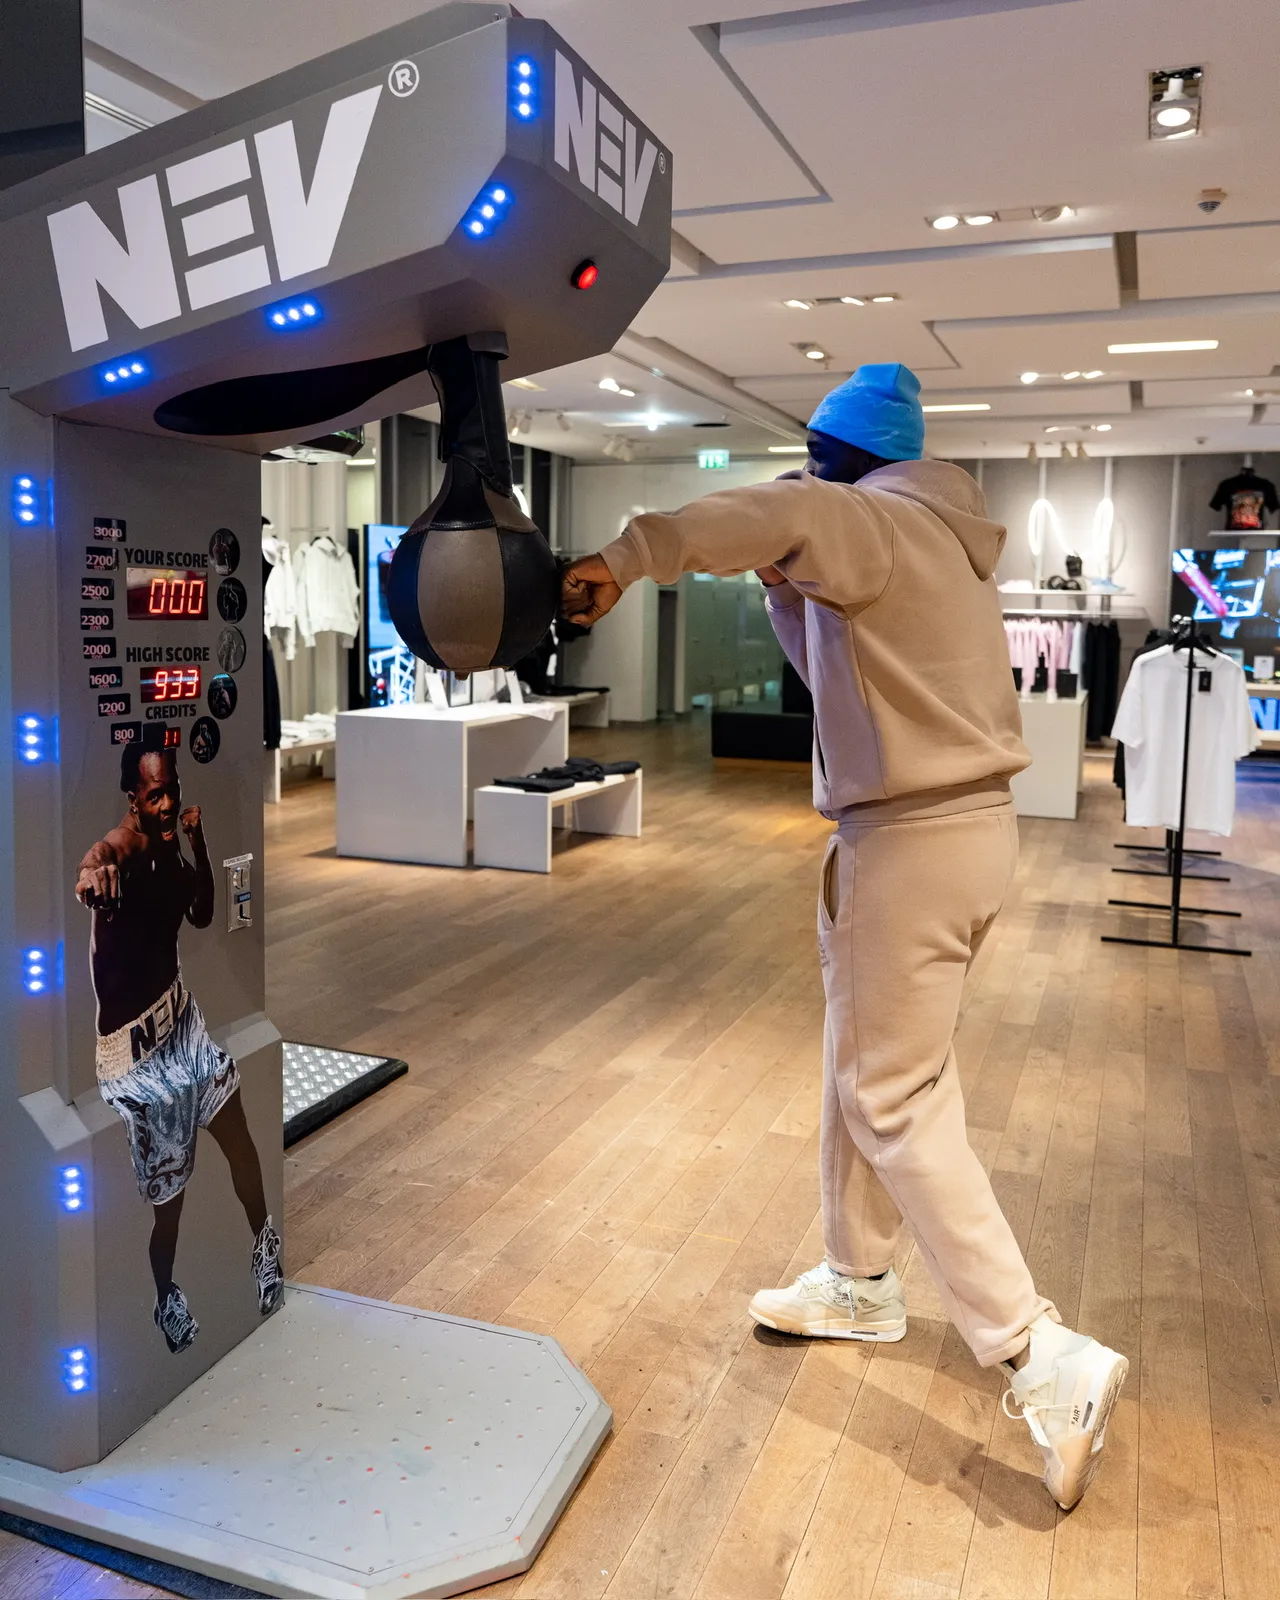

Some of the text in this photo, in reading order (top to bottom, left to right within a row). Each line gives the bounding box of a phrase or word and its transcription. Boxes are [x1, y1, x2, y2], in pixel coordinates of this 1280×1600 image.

[94, 526, 122, 538] 3000
[86, 554, 113, 566] 2700
[124, 548, 209, 568] YOUR SCORE
[82, 585, 109, 596] 2500
[149, 578, 204, 614] 000
[81, 615, 109, 626] 2300
[83, 644, 110, 655] 2000
[126, 647, 210, 662] HIGH SCORE
[90, 673, 117, 685] 1600
[154, 669, 198, 699] 933
[99, 701, 125, 713] 1200
[145, 704, 196, 720] CREDITS
[114, 728, 134, 740] 800
